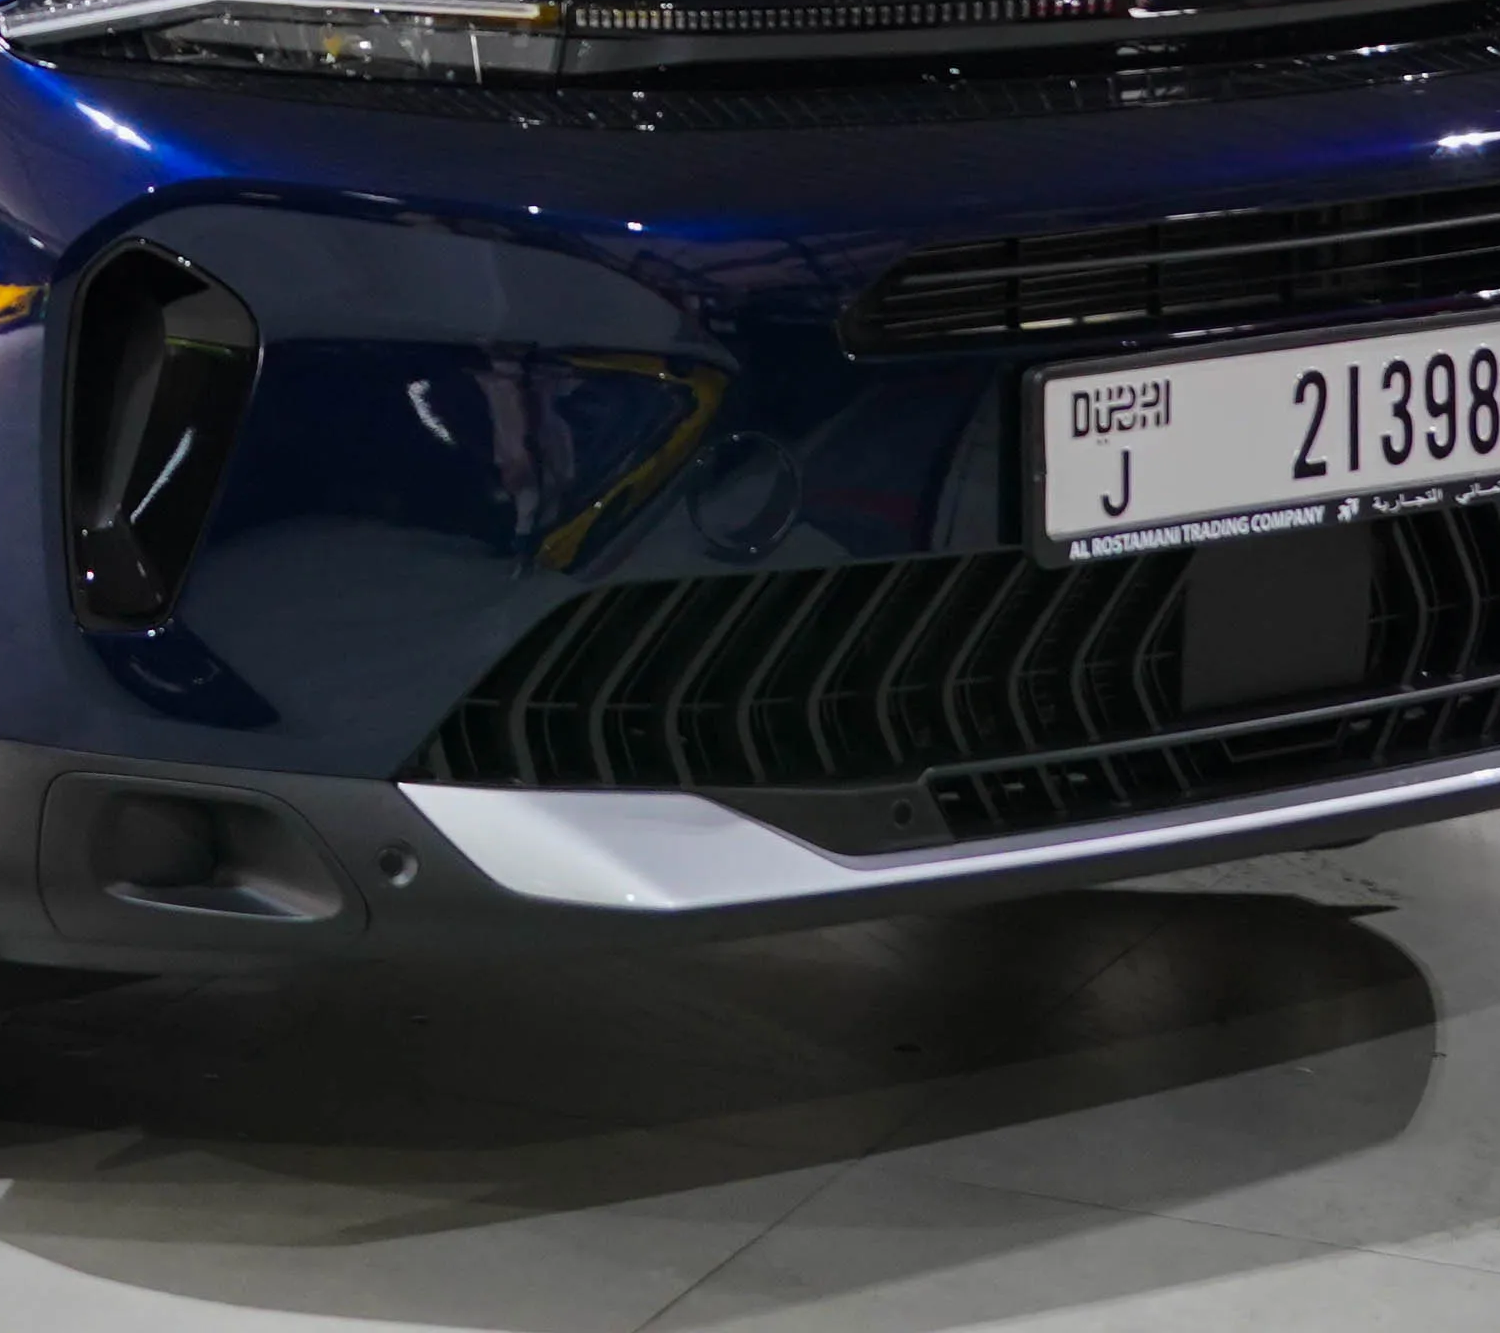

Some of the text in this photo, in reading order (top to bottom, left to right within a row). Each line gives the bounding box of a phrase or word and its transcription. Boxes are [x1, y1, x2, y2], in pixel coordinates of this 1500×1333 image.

[1293, 347, 1500, 479] 21398
[1102, 449, 1132, 517] J
[1069, 504, 1326, 560] AL ROSTAMANI TRADING COMPANY
